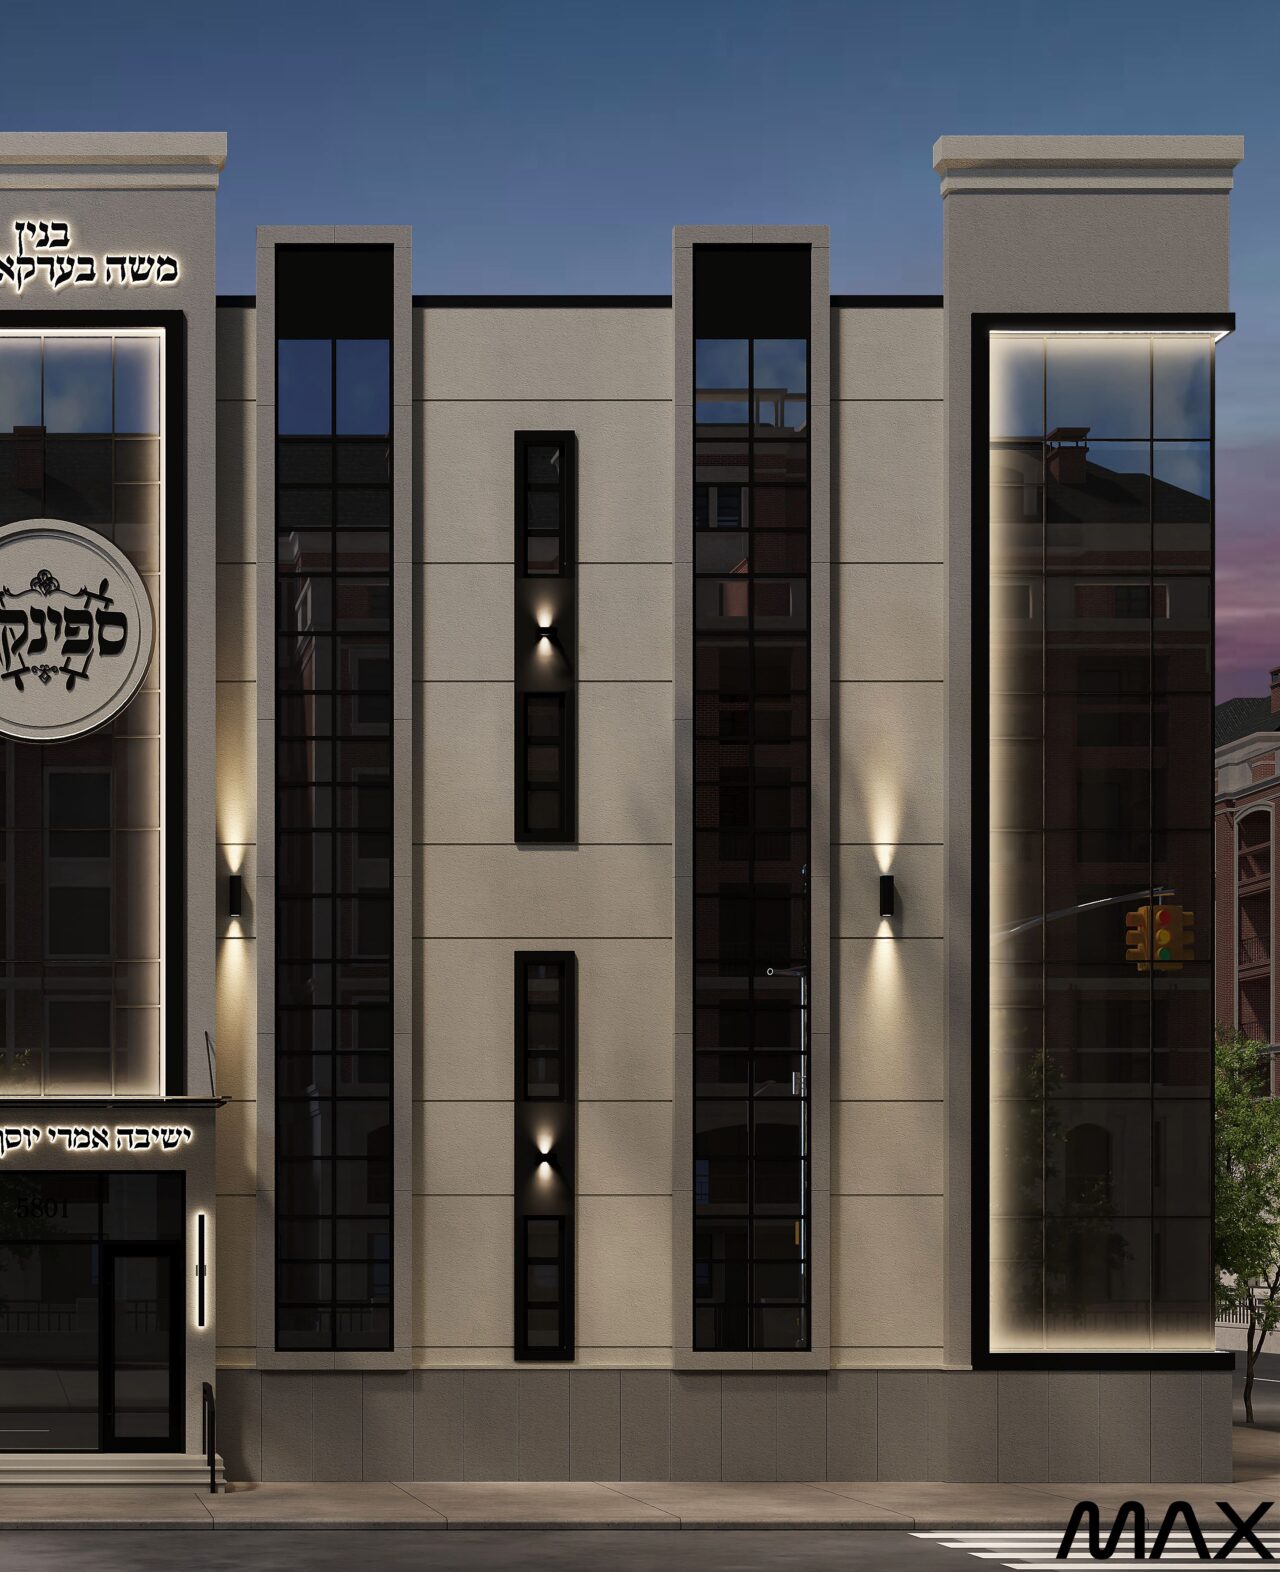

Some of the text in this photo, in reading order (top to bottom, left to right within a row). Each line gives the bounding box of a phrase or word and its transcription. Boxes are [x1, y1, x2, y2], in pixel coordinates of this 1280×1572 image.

[14, 220, 71, 256] בנין
[104, 254, 179, 284] משה
[48, 1127, 109, 1150] אמרי
[116, 1127, 192, 1150] ישיבה
[17, 1198, 69, 1218] 5801
